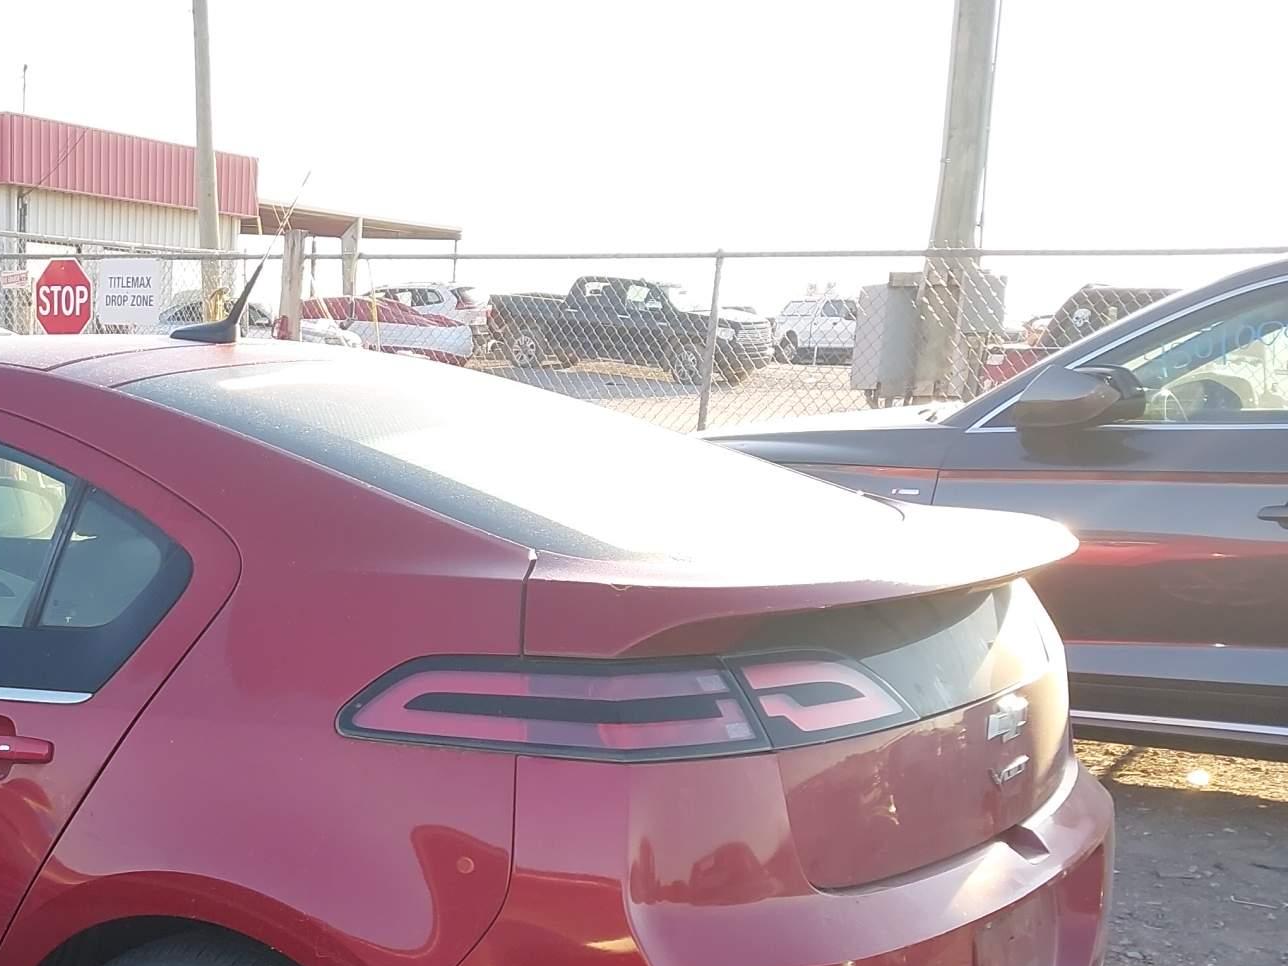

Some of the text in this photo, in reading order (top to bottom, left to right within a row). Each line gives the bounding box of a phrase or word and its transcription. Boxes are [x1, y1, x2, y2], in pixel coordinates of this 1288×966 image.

[108, 276, 152, 289] TITLEMAX
[38, 285, 89, 317] STOP
[105, 294, 154, 307] DROP ZONE
